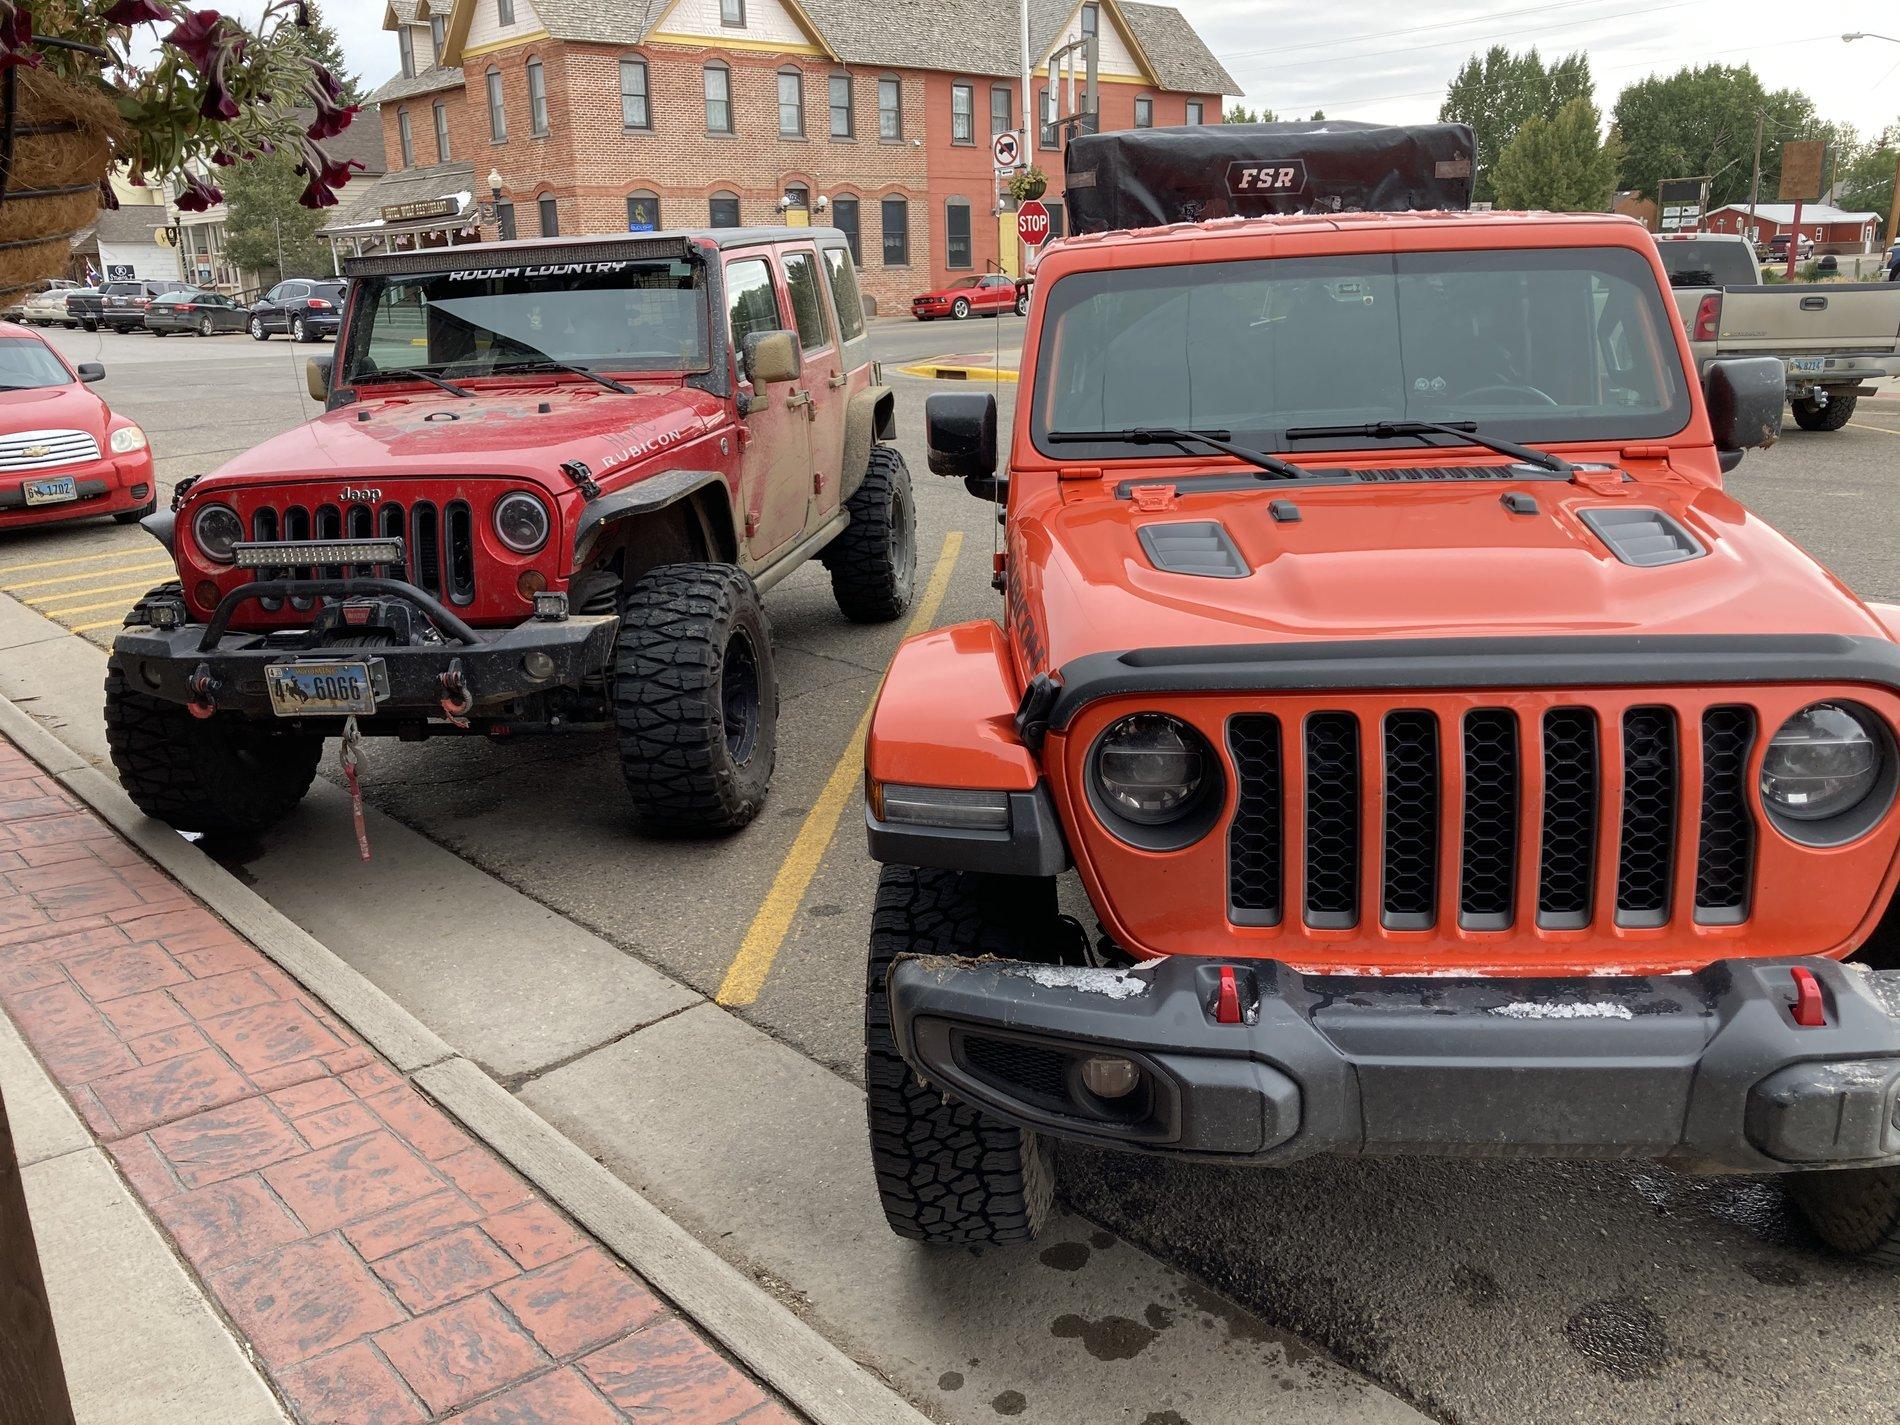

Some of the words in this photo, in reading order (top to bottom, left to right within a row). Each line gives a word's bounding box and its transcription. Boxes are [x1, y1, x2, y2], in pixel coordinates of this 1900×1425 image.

[1238, 167, 1294, 188] FSR
[1019, 214, 1046, 232] STOP
[449, 267, 520, 282] ROUGH
[524, 261, 627, 277] COUNTRY
[601, 429, 681, 468] RUBICON
[46, 482, 70, 497] 1702
[339, 486, 382, 504] Jeep
[275, 678, 286, 702] 4
[313, 676, 361, 700] 6066
